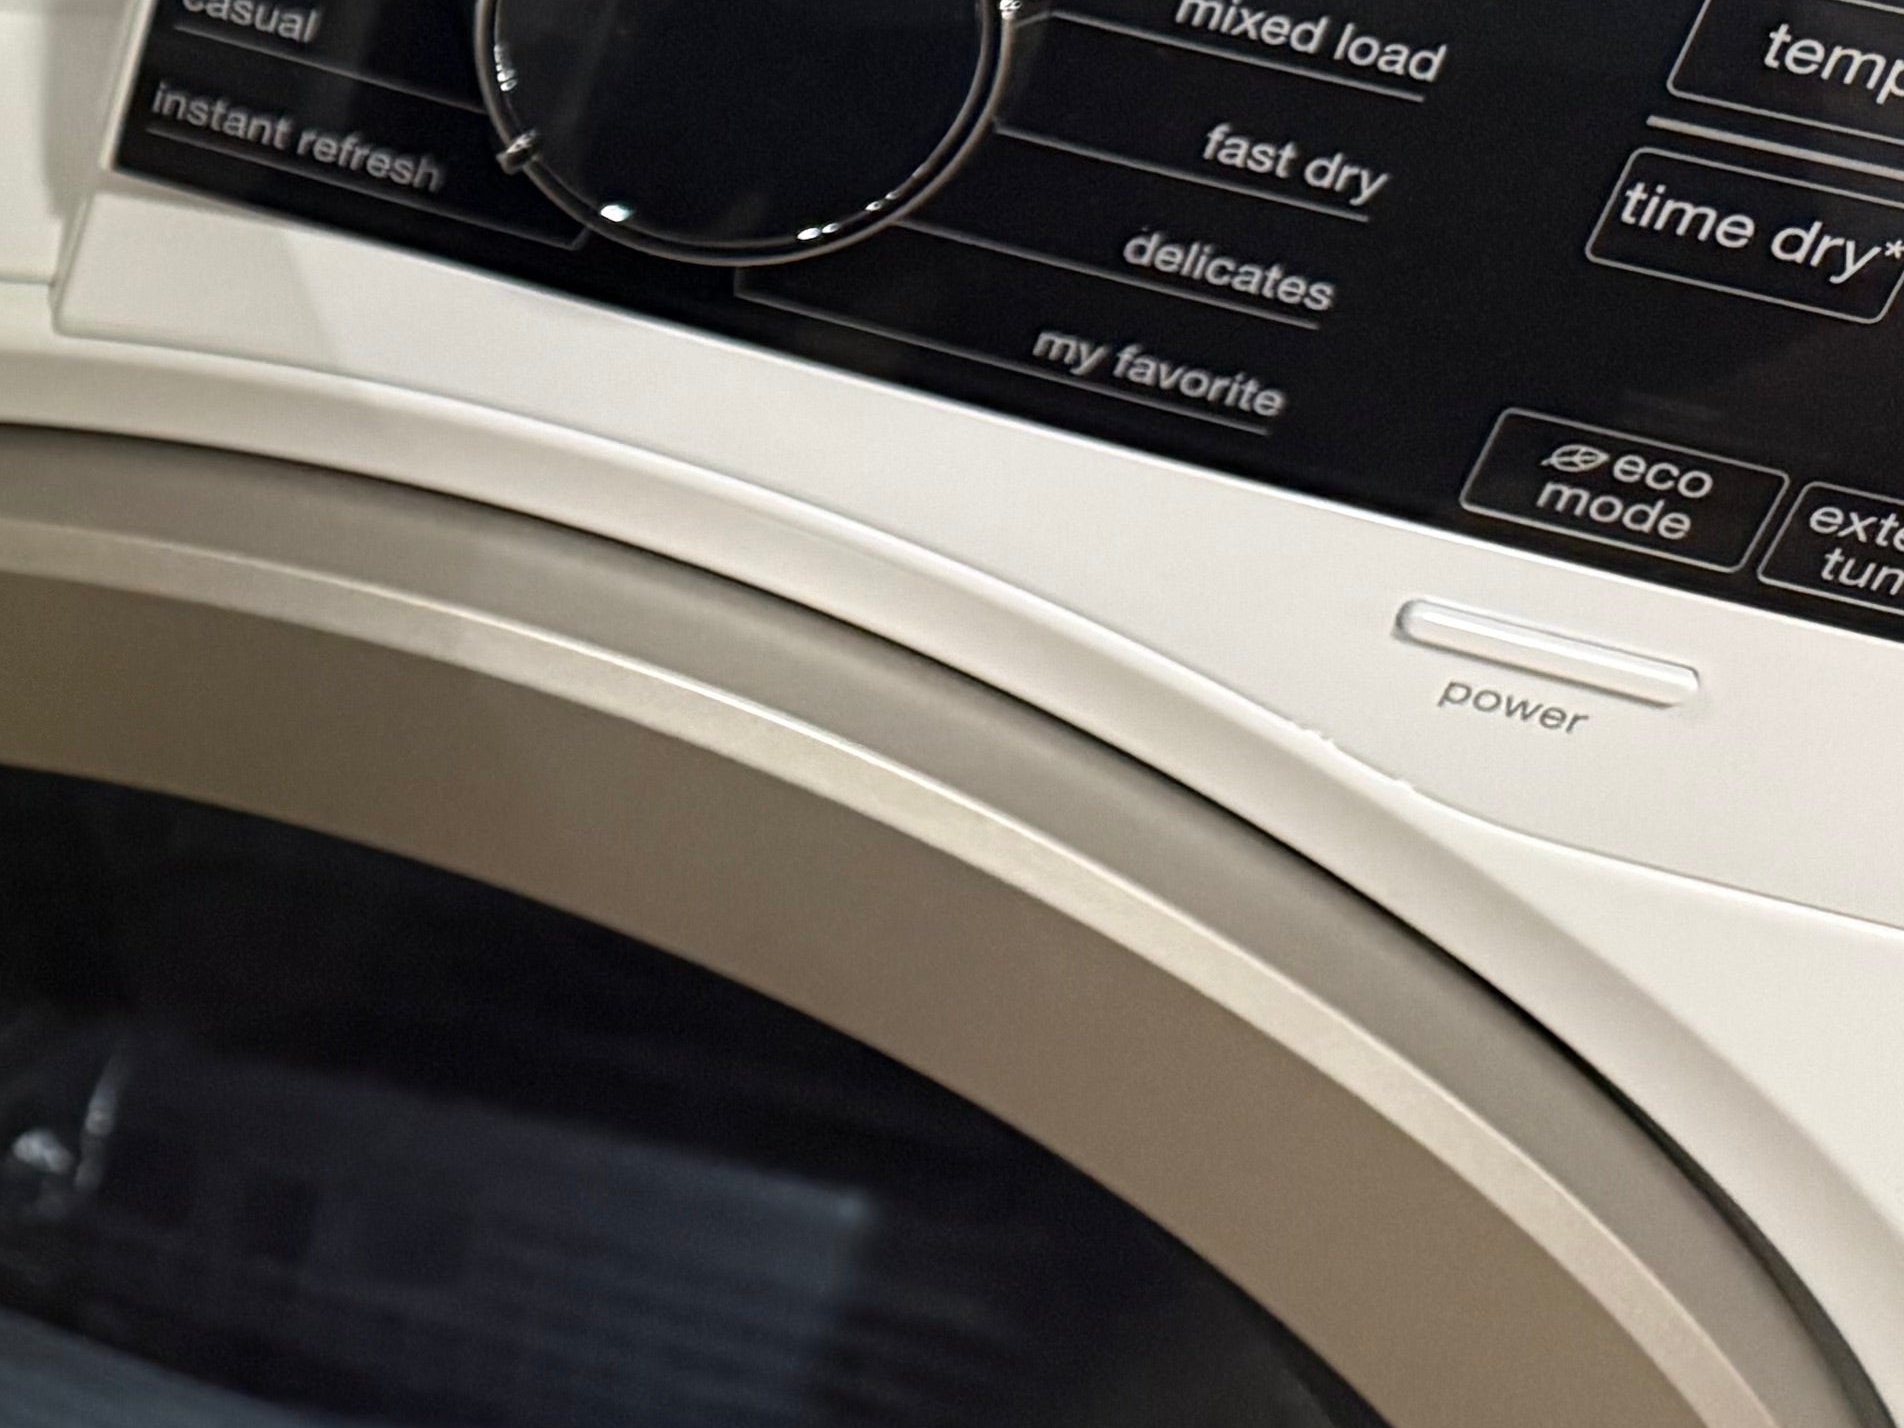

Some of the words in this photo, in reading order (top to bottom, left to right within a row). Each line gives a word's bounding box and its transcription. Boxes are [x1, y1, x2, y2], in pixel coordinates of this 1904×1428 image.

[1334, 24, 1446, 84] load
[1764, 24, 1904, 105] temp
[152, 82, 291, 151] instant
[297, 122, 442, 193] refresh
[1203, 122, 1296, 180] fast
[1304, 143, 1389, 206] dry
[1620, 182, 1755, 248] time
[1123, 226, 1334, 312] delicates
[1033, 328, 1104, 376] my
[1113, 342, 1285, 418] favorite
[1536, 481, 1692, 540] mode
[1613, 453, 1713, 499] eco
[1437, 677, 1589, 735] power
